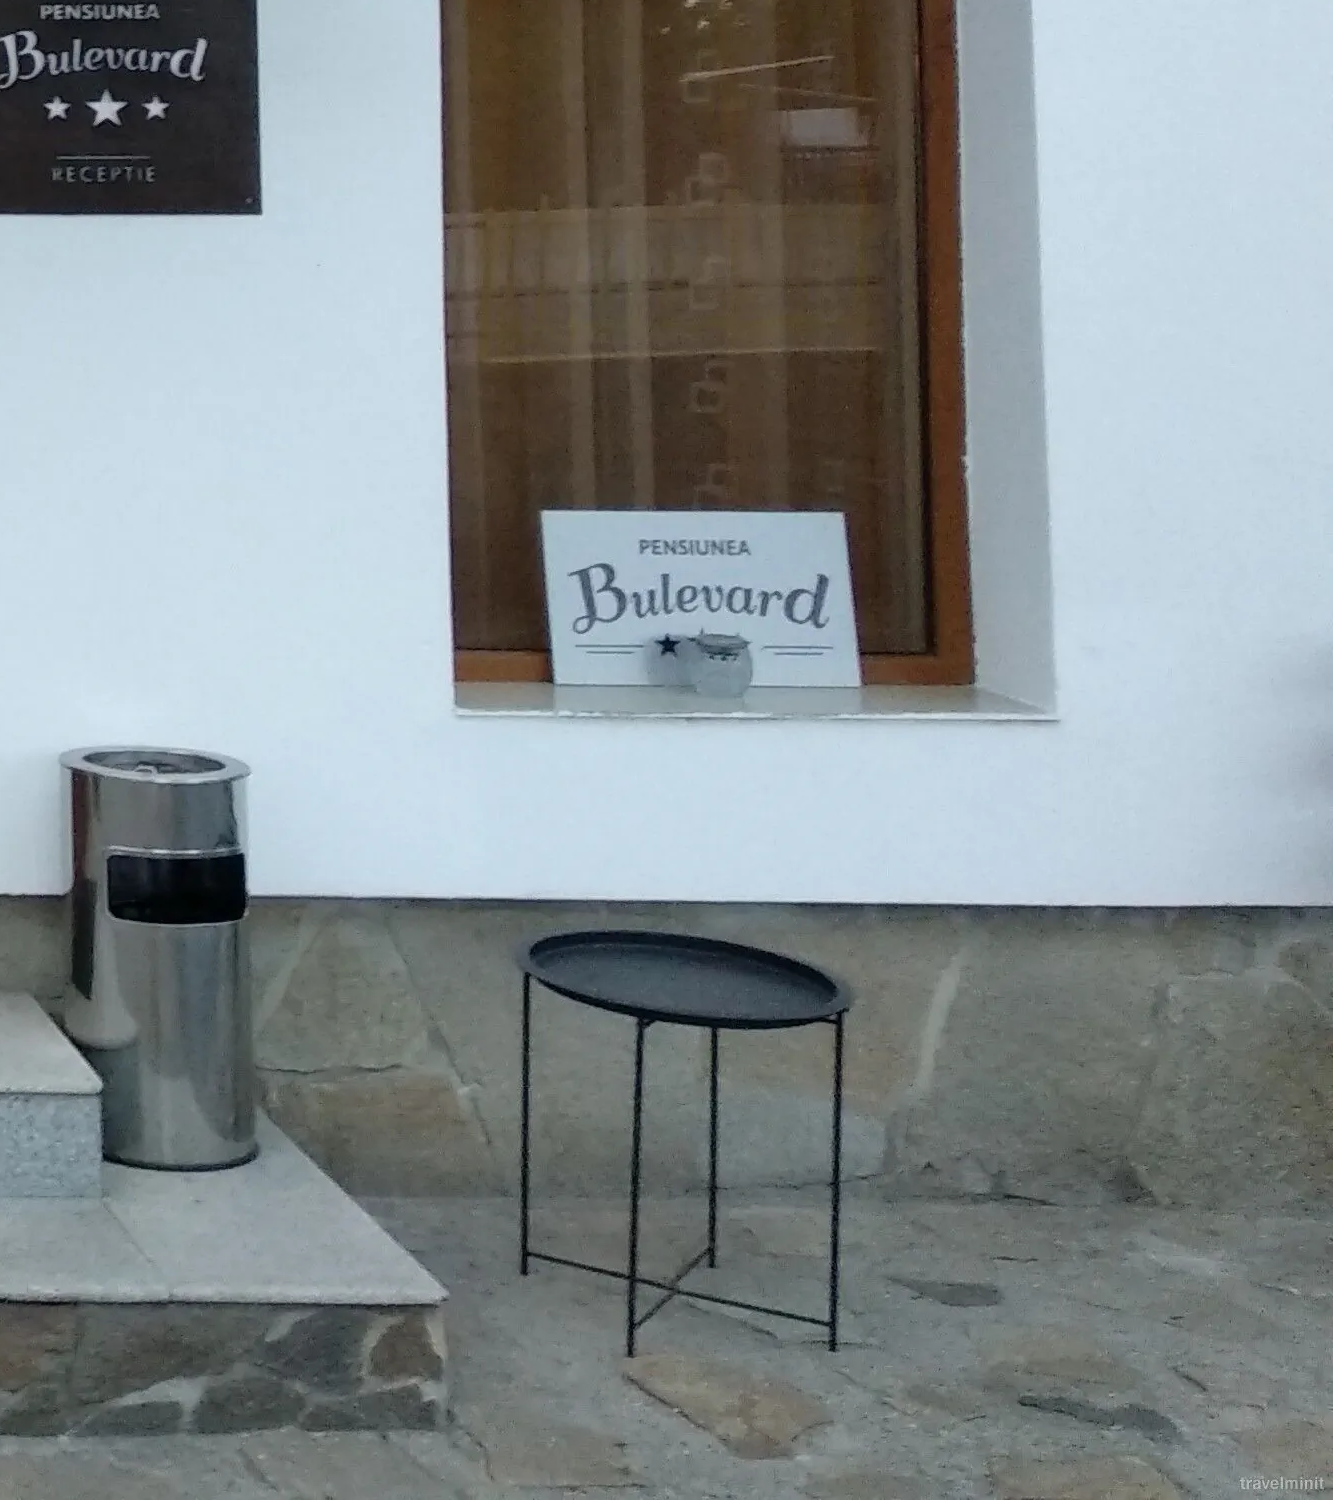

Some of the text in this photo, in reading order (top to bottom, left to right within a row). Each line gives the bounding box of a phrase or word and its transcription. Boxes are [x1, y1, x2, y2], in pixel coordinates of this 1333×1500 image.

[39, 3, 161, 21] PENSIUNEA
[51, 165, 157, 183] RECEPTIE
[638, 538, 752, 557] PENSIUNEA
[567, 562, 830, 635] Bulevard
